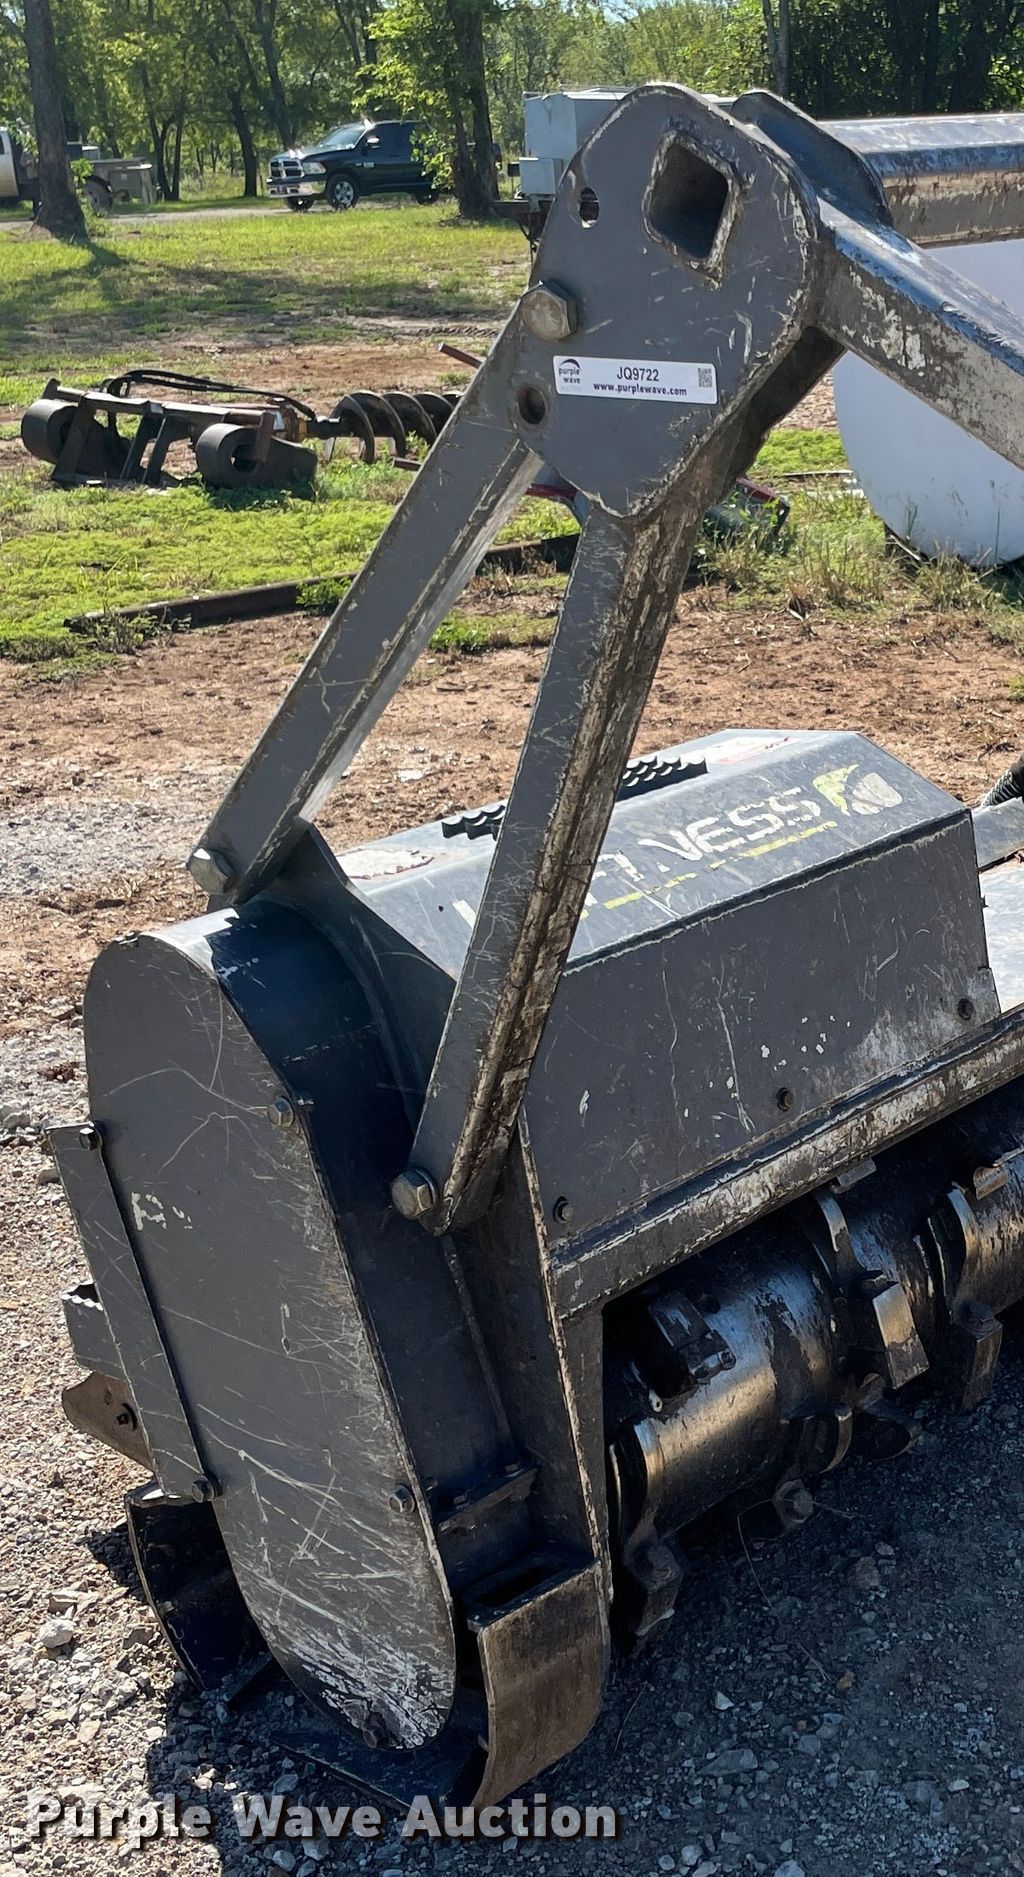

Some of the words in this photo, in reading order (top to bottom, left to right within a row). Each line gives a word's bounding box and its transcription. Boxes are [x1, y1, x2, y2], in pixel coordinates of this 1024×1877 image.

[559, 367, 580, 376] purple
[617, 366, 660, 382] JQ9722
[593, 382, 687, 396] www.purplewave.com
